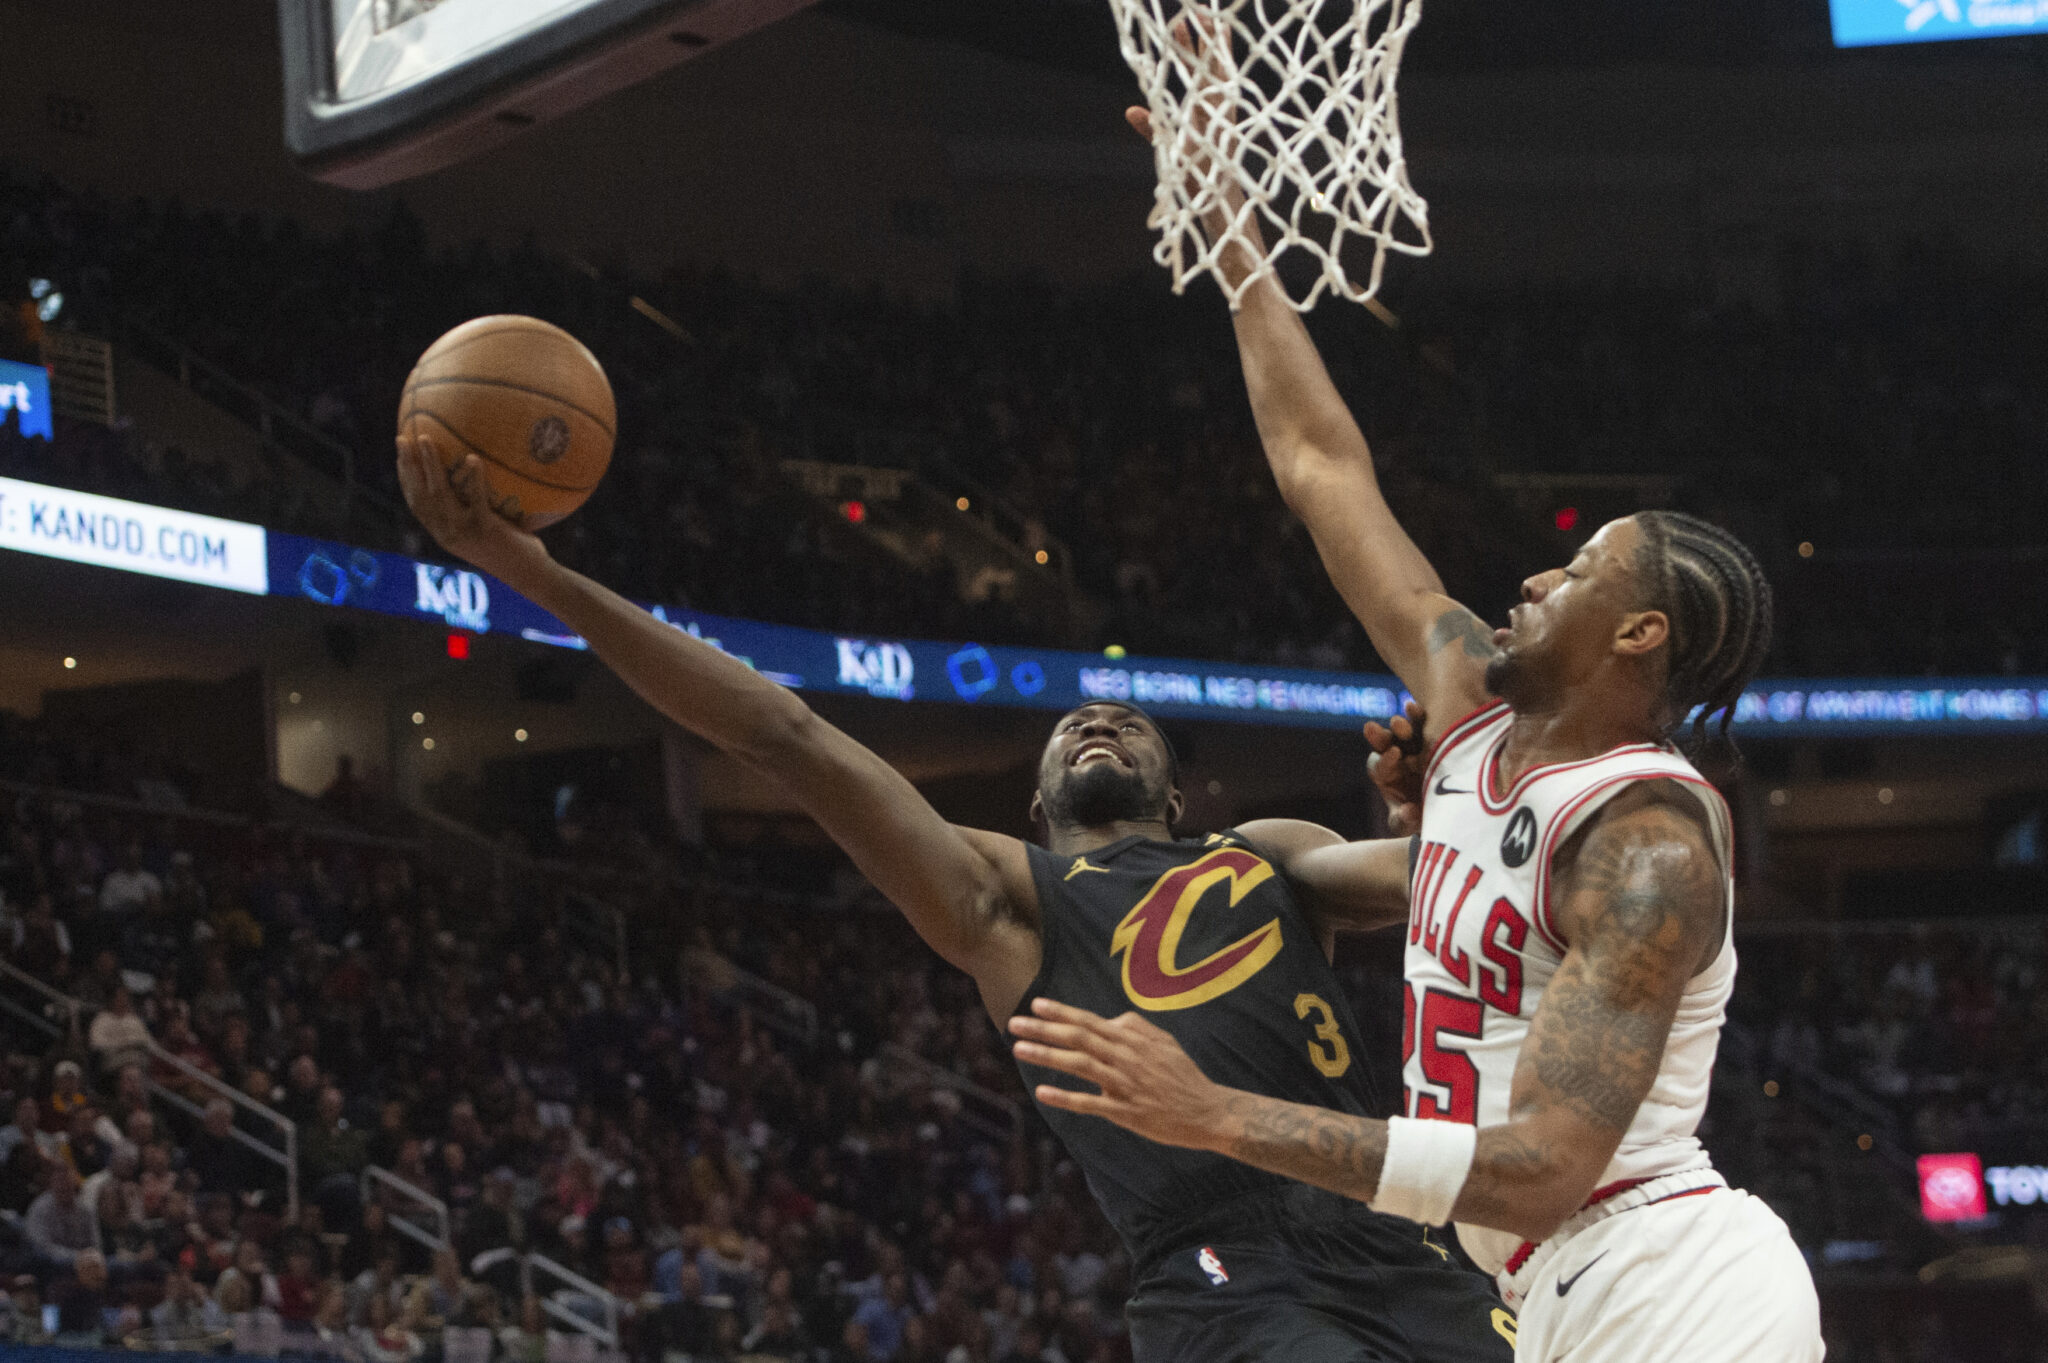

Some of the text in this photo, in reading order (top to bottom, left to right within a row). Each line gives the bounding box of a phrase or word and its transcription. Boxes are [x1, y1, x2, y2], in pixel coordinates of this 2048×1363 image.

[1110, 847, 1284, 1012] C
[1410, 840, 1529, 1016] ULLS
[1294, 993, 1351, 1078] 3
[1404, 980, 1485, 1126] 5
